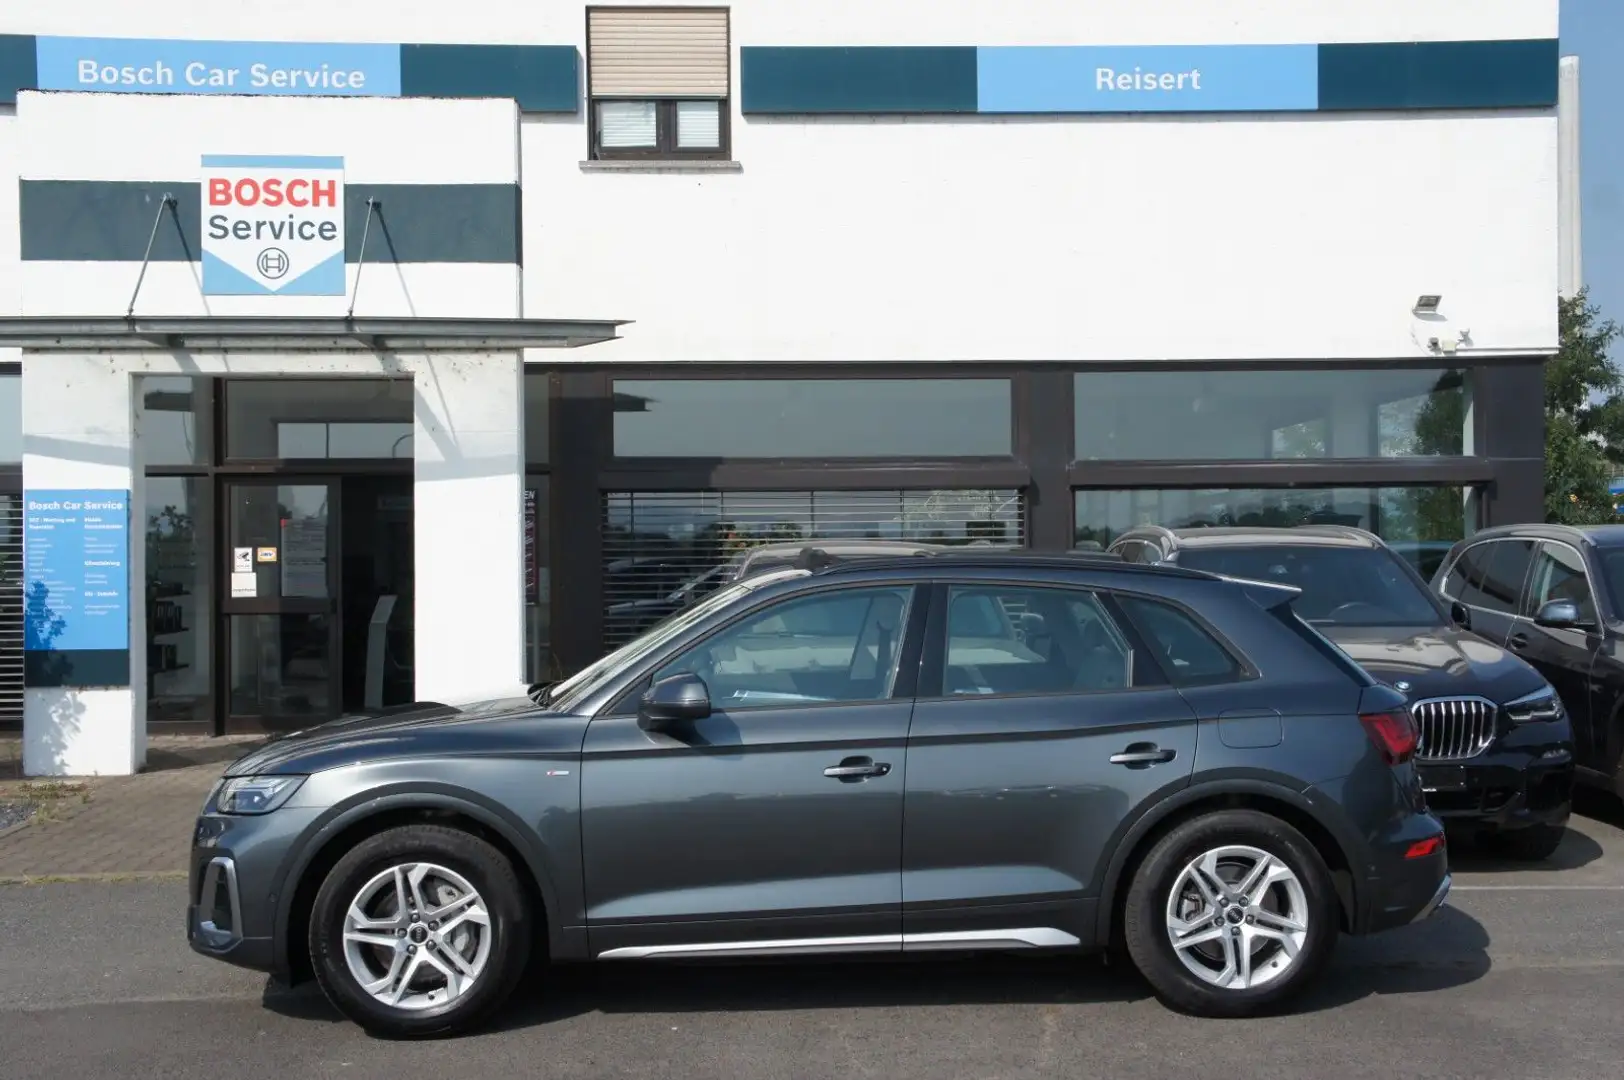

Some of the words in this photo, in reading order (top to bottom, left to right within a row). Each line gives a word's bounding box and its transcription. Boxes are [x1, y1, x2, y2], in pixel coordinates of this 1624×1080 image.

[78, 59, 173, 85] Bosch
[185, 62, 240, 87] Car
[250, 63, 366, 88] Service
[1095, 66, 1202, 91] Reisert
[209, 177, 336, 207] BOSCH
[208, 213, 338, 241] Service
[29, 500, 60, 511] Bosch
[62, 500, 81, 511] Car
[84, 500, 123, 511] Service
